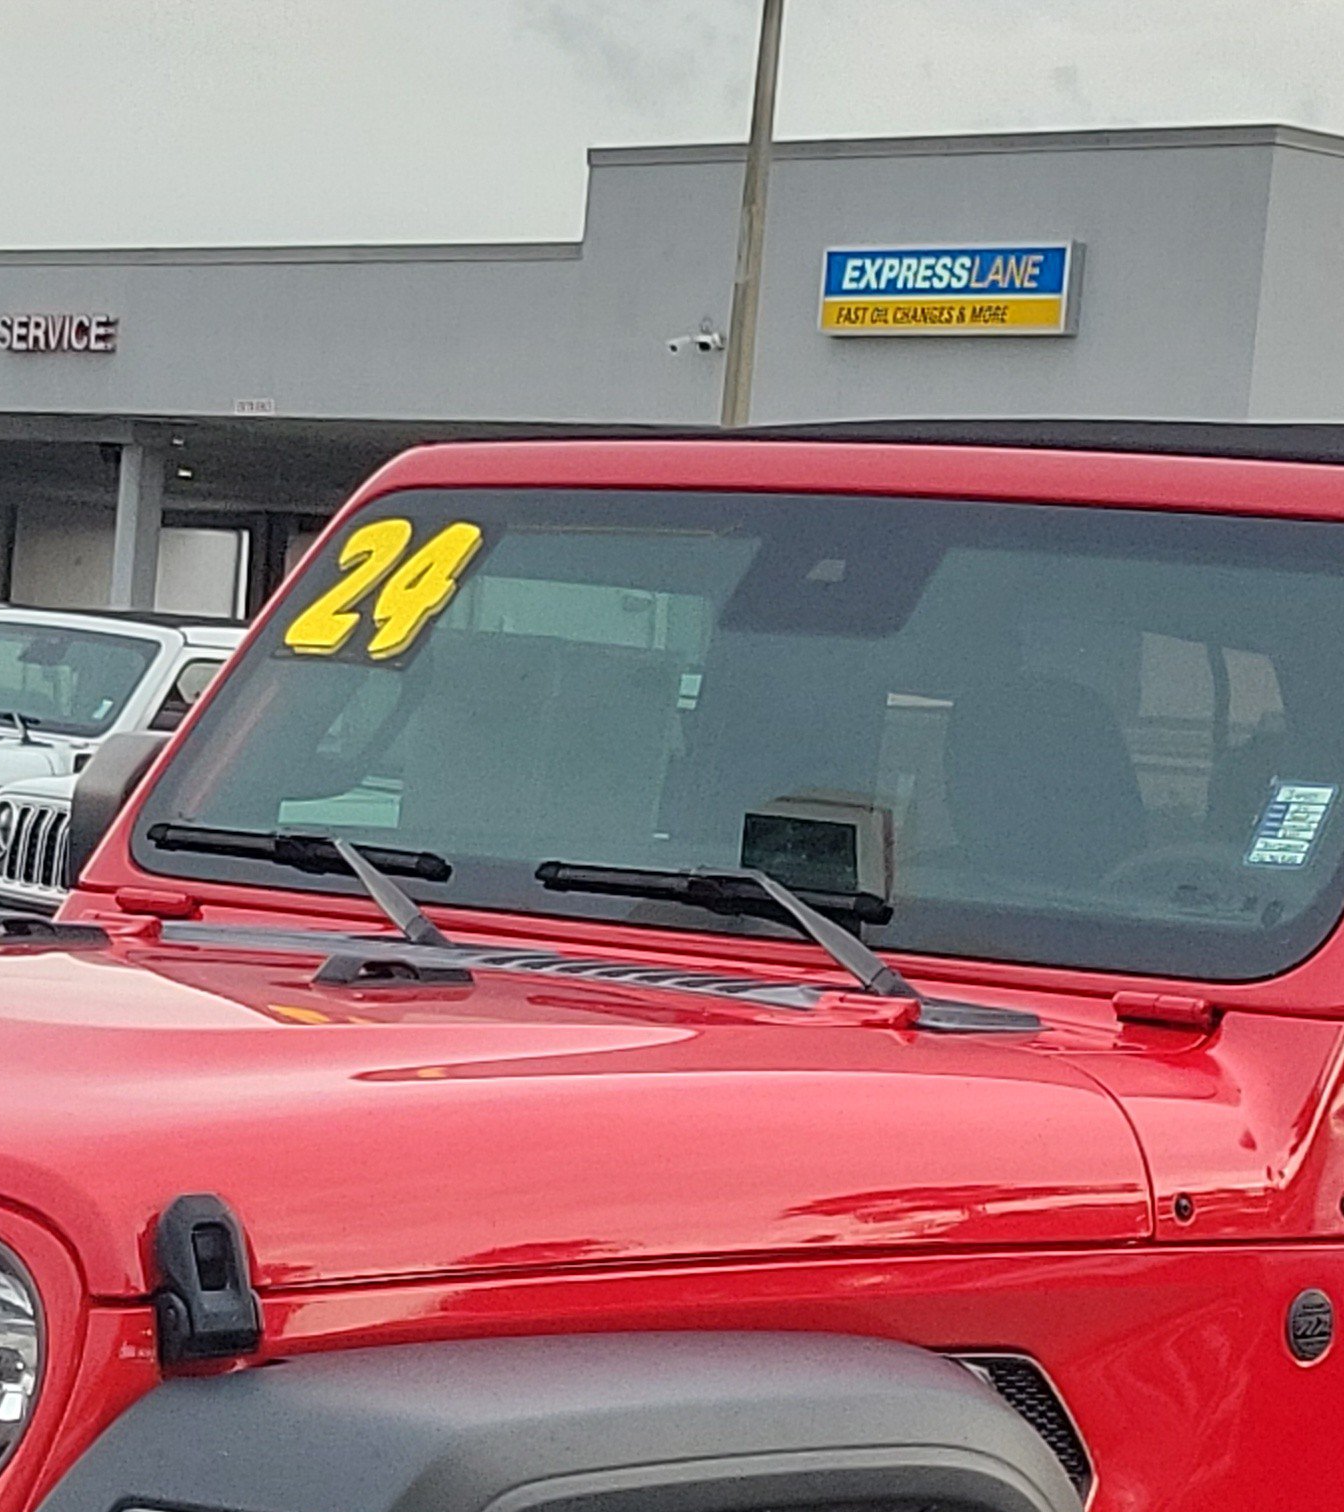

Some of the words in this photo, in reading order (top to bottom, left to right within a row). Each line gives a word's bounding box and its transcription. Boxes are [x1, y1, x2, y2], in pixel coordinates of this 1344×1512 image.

[835, 306, 868, 324] FAST
[892, 305, 954, 324] CHANGES
[970, 304, 1008, 323] MORE
[284, 518, 483, 660] 24
